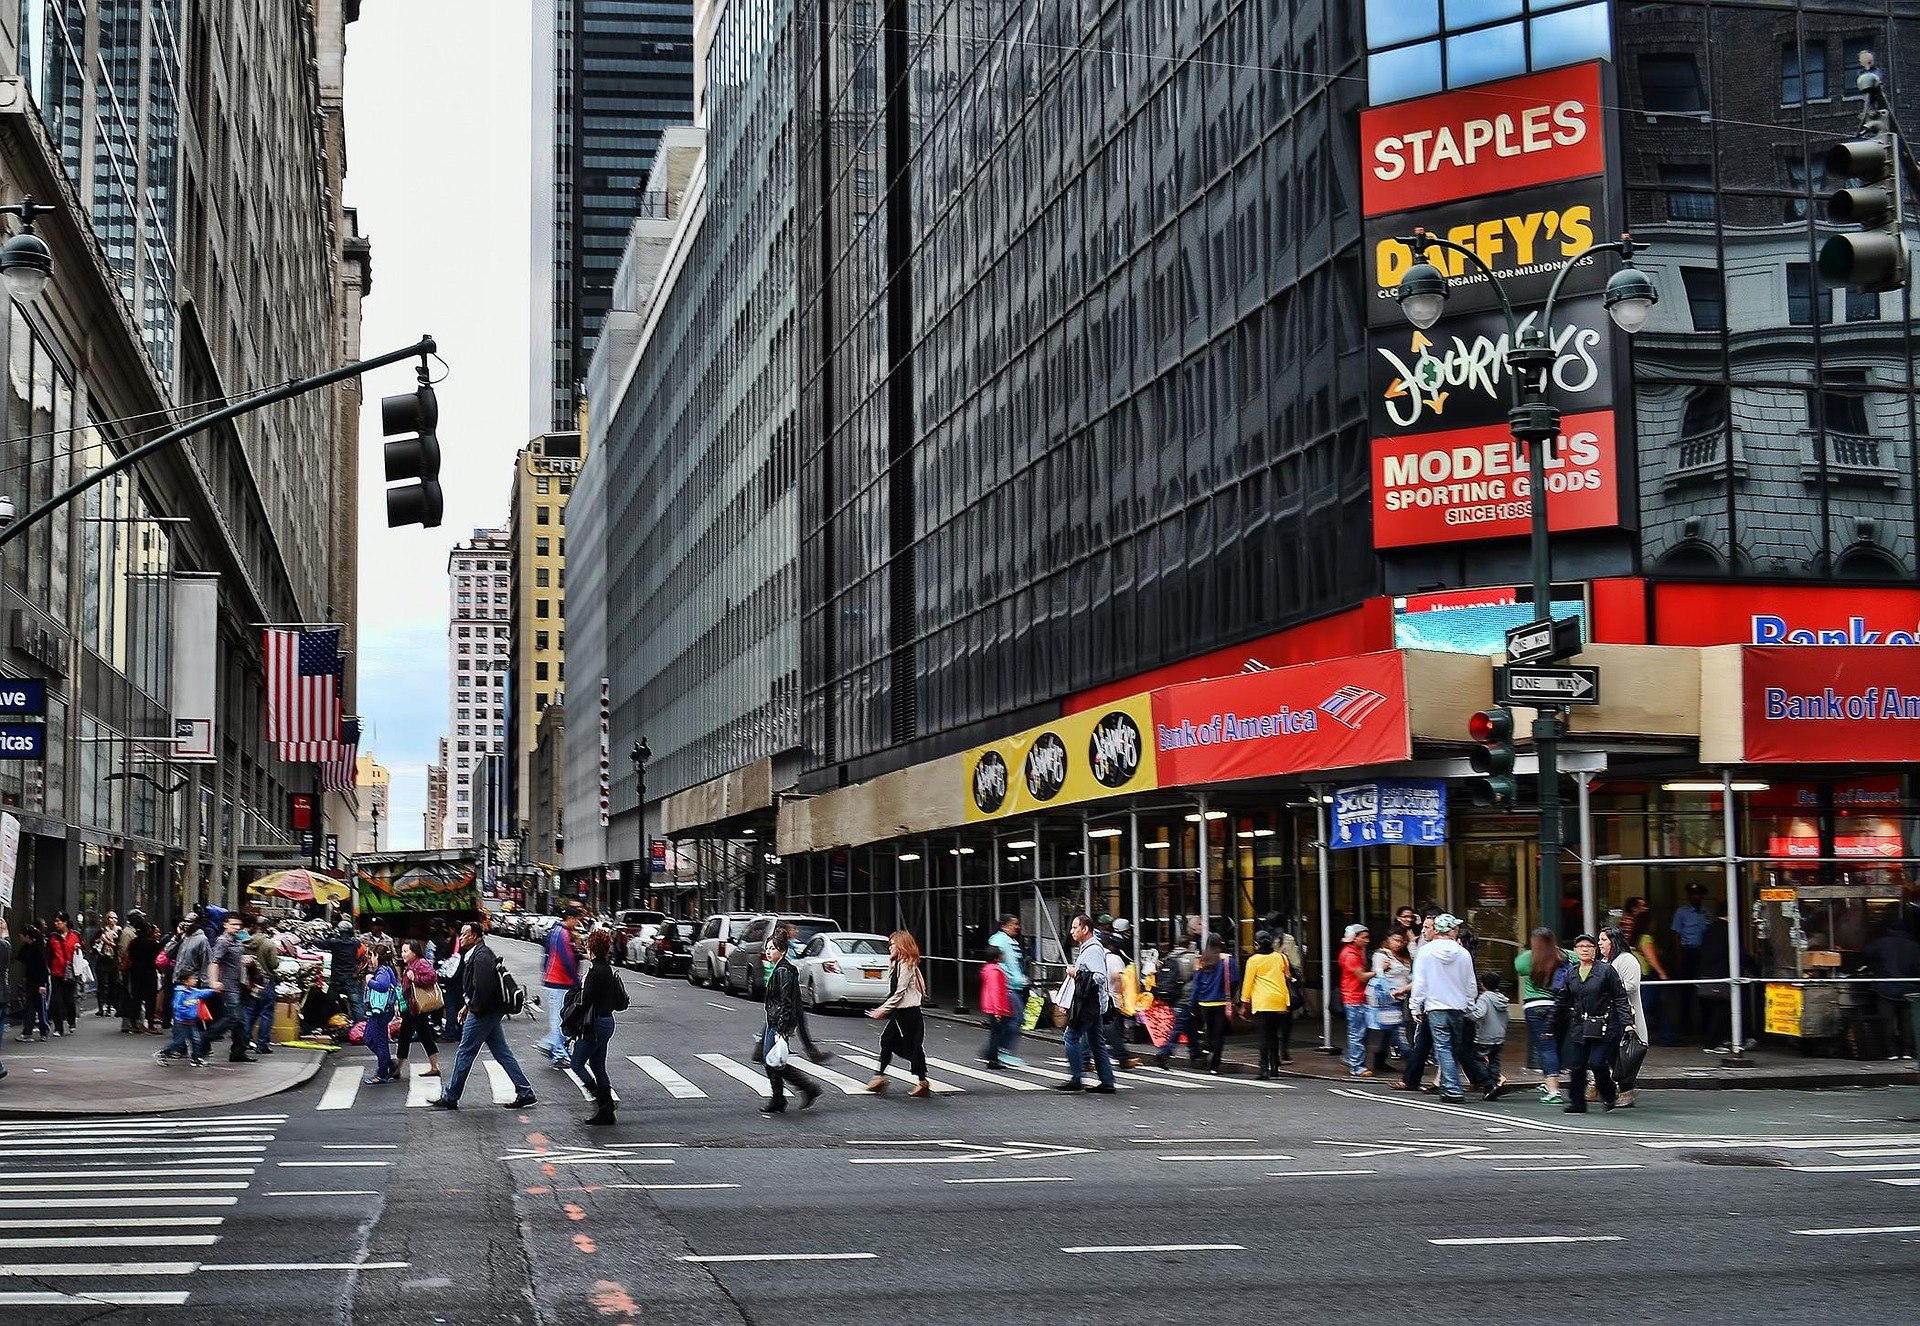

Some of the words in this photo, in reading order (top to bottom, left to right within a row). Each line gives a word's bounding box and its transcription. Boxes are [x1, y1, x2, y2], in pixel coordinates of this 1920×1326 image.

[1373, 100, 1587, 181] STAPLES
[1376, 206, 1594, 287] DAFFY'S
[1515, 255, 1594, 277] MILLIONAES
[1383, 432, 1600, 488] MODELL'S
[1385, 480, 1505, 511] SPORTING
[1511, 469, 1602, 497] GODS
[1445, 505, 1496, 525] SINCE
[1515, 678, 1541, 688] ONE
[1557, 678, 1582, 690] WAY
[1765, 687, 1845, 719] Bank
[1846, 686, 1879, 720] of
[1157, 719, 1198, 752] Bank
[1198, 714, 1222, 745] of
[1222, 705, 1319, 743] America
